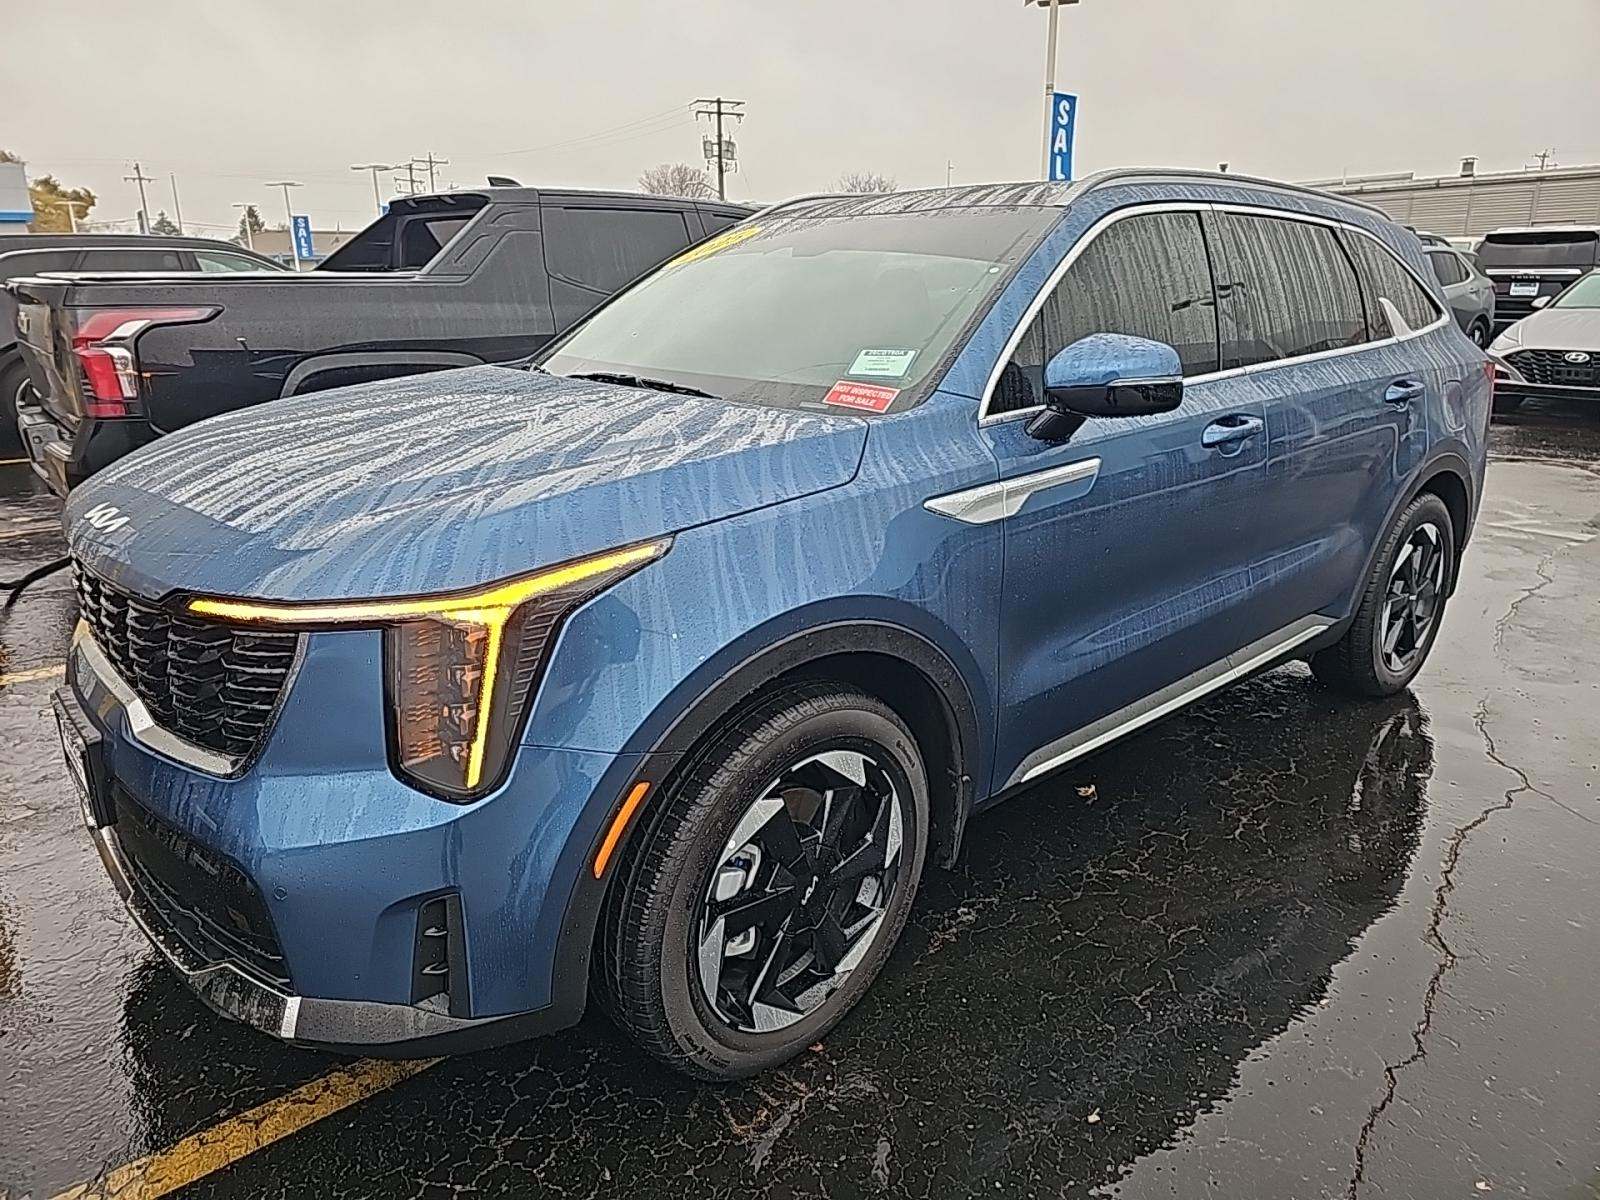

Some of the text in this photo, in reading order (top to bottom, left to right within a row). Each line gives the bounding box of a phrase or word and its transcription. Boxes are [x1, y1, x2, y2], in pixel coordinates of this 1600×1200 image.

[1053, 99, 1071, 180] SAL
[297, 217, 310, 257] SALE
[833, 384, 893, 400] NOT INSPECTED
[838, 394, 877, 407] FOR SALE
